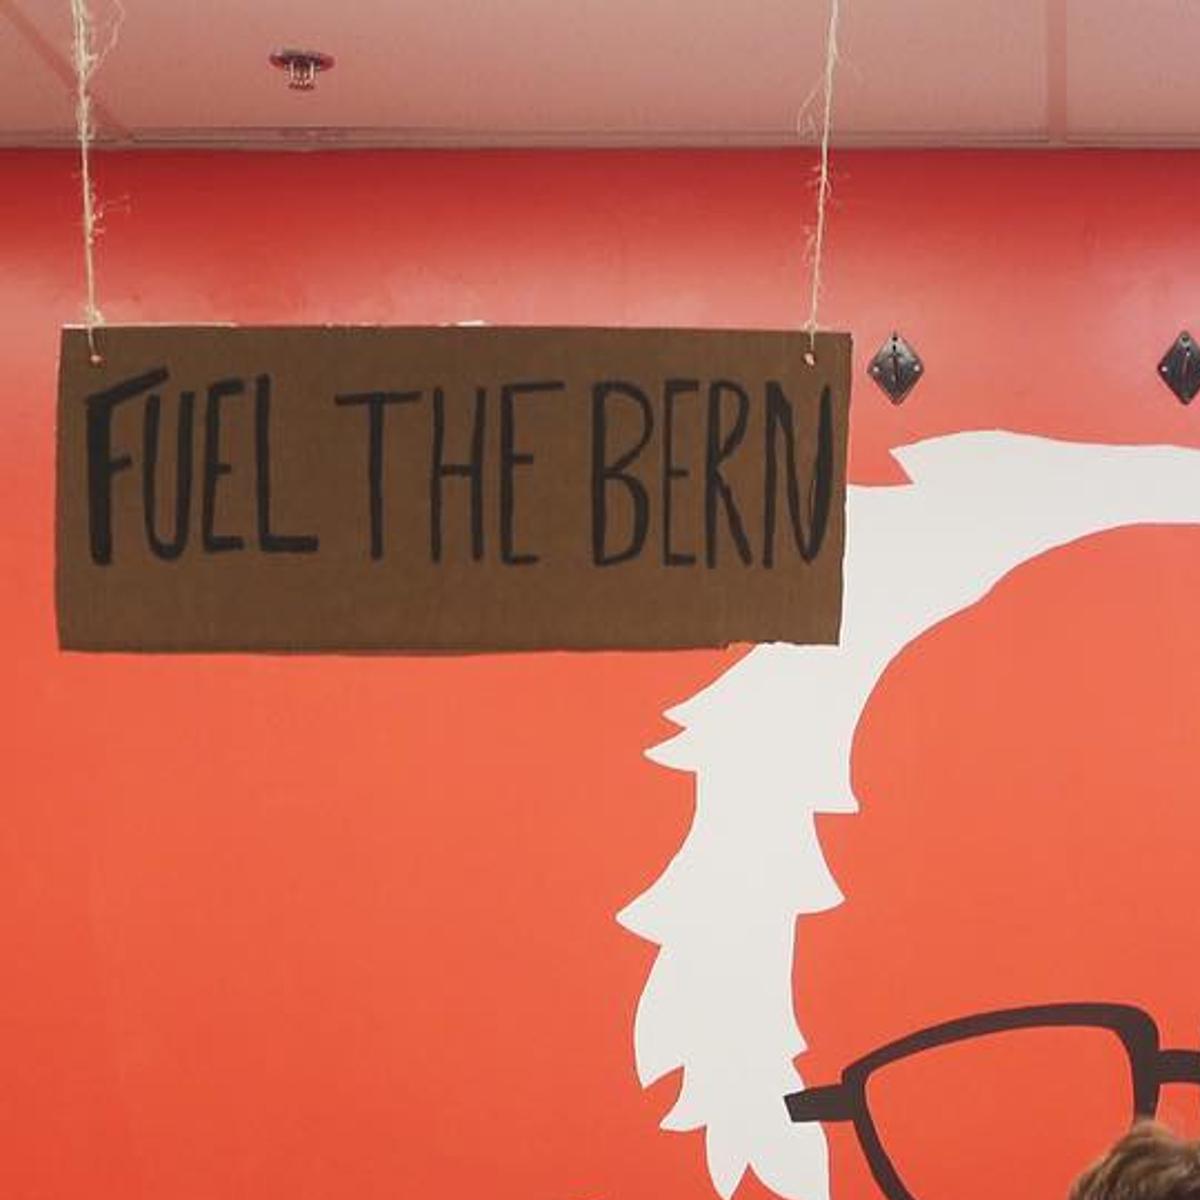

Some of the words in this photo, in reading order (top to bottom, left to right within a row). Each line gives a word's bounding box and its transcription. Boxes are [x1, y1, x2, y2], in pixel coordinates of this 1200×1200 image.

[85, 366, 319, 567] FUEL
[334, 380, 565, 567] THE
[590, 379, 833, 569] BERN
